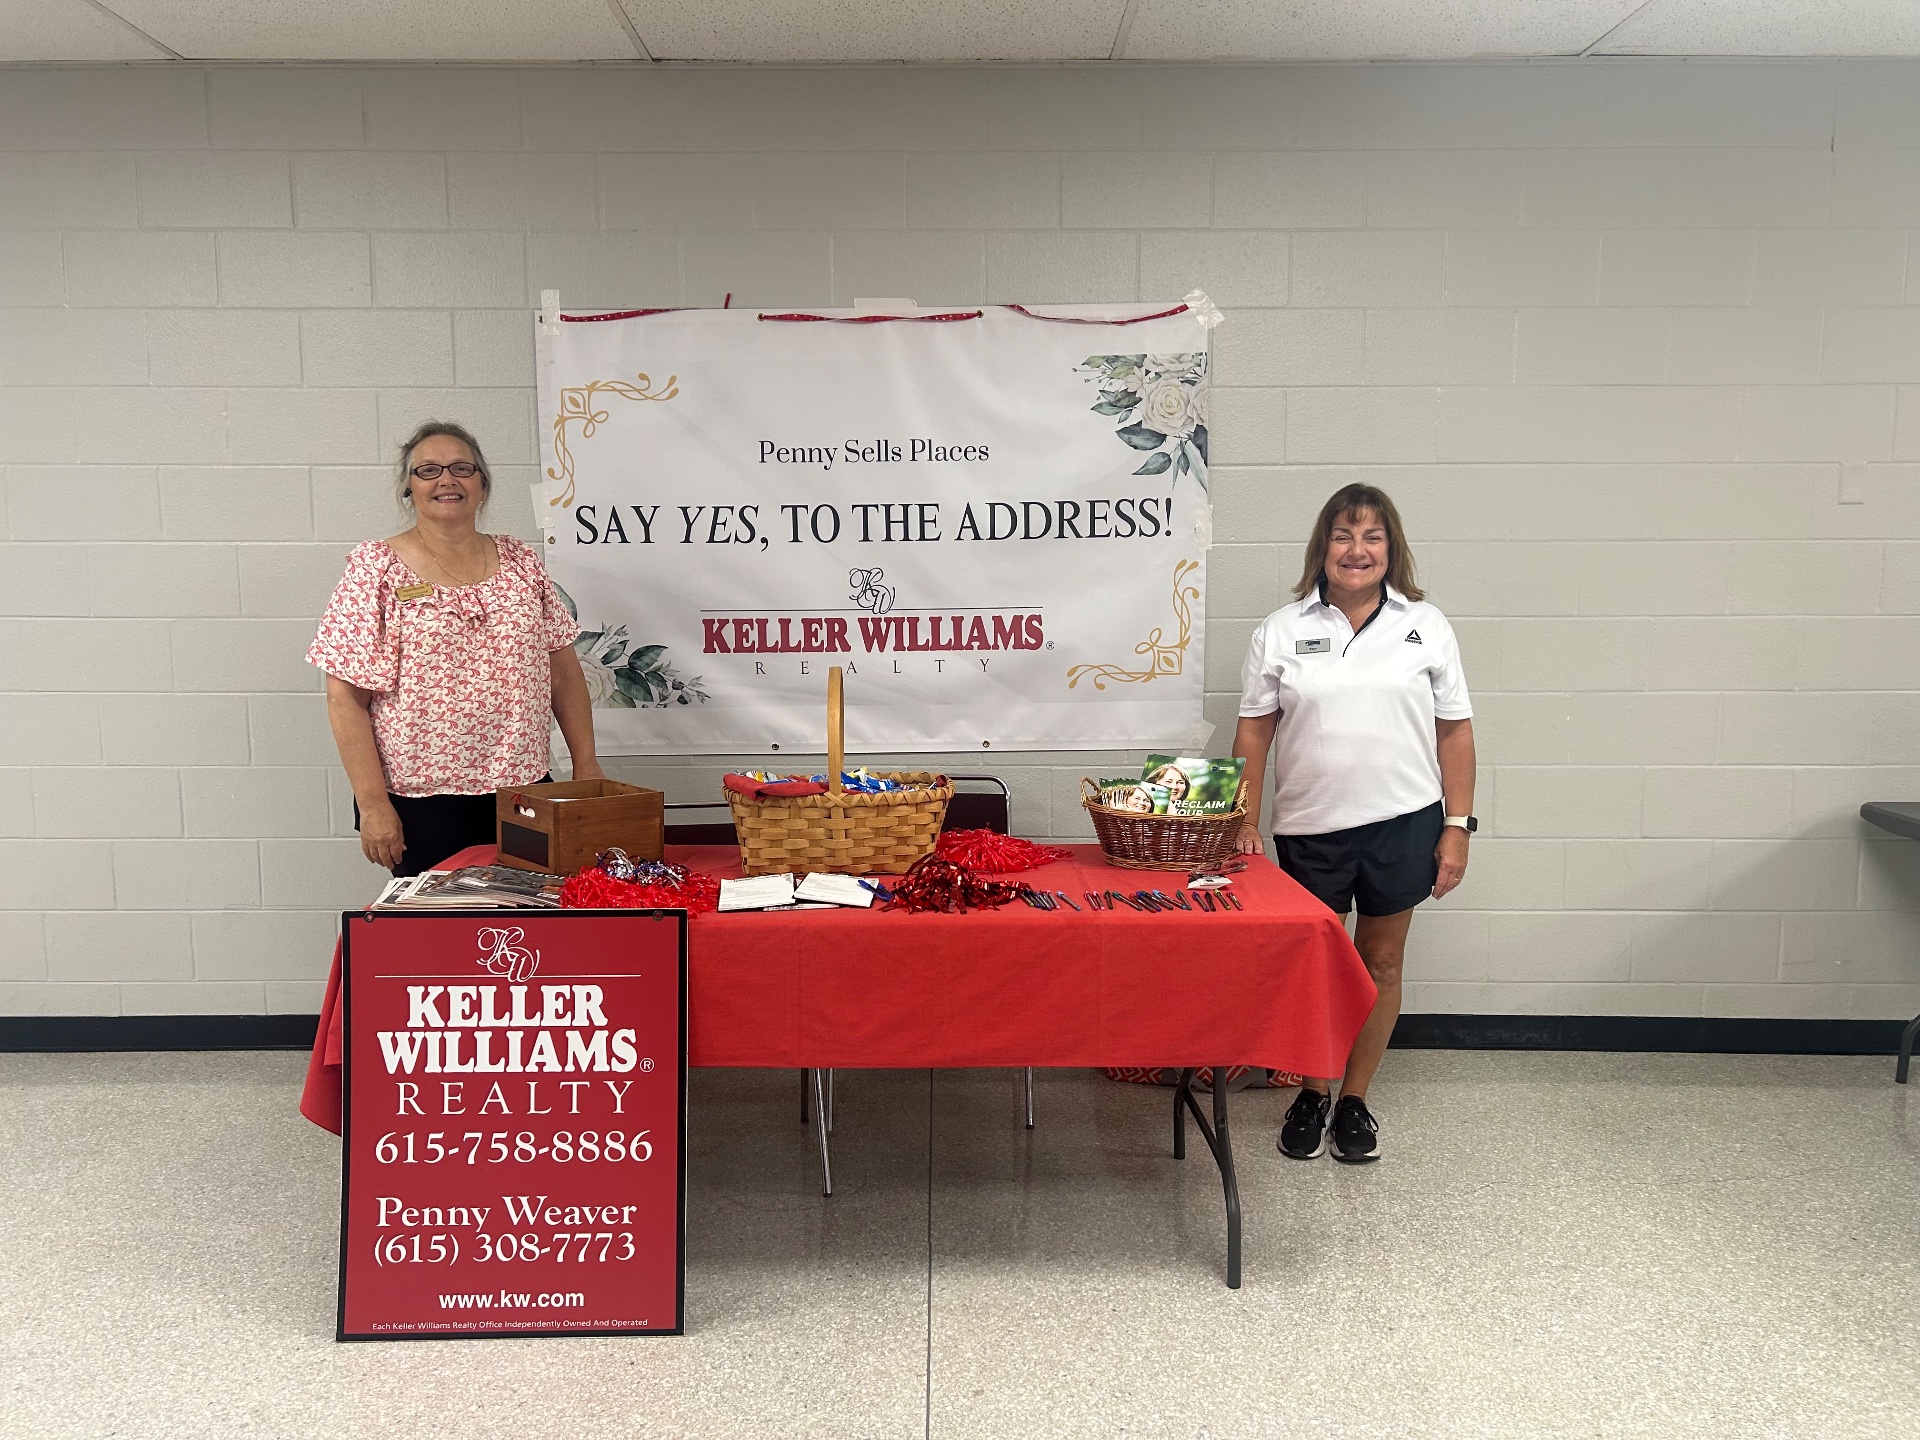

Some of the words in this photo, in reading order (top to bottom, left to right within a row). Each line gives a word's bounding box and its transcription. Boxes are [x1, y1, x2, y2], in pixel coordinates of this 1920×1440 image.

[758, 440, 838, 470] Penny
[844, 439, 902, 464] Sells
[909, 438, 990, 463] Places
[574, 504, 661, 545] SAY
[678, 504, 769, 552] YES,
[780, 503, 841, 544] TO
[851, 502, 942, 543] THE
[955, 497, 1174, 542] ADDRESS!
[702, 616, 851, 654] KELLER
[755, 658, 990, 676] REALTY
[1174, 800, 1226, 809] RECLAIM
[406, 984, 608, 1028] KELLER
[396, 1080, 635, 1116] REALTY
[375, 1130, 653, 1165] 615-758-8886
[375, 1196, 491, 1232] Penny
[502, 1195, 638, 1226] Weaver
[374, 1234, 460, 1267] (615)
[472, 1231, 636, 1263] 308-7773
[438, 1289, 585, 1309] www.kw.com
[393, 1322, 416, 1330] Keller
[418, 1322, 451, 1330] Williams
[453, 1321, 477, 1330] Realty
[479, 1320, 503, 1329] Office
[504, 1319, 561, 1329] Independently
[563, 1319, 591, 1327] Owned
[593, 1319, 610, 1327] And
[611, 1318, 648, 1328] Operated
